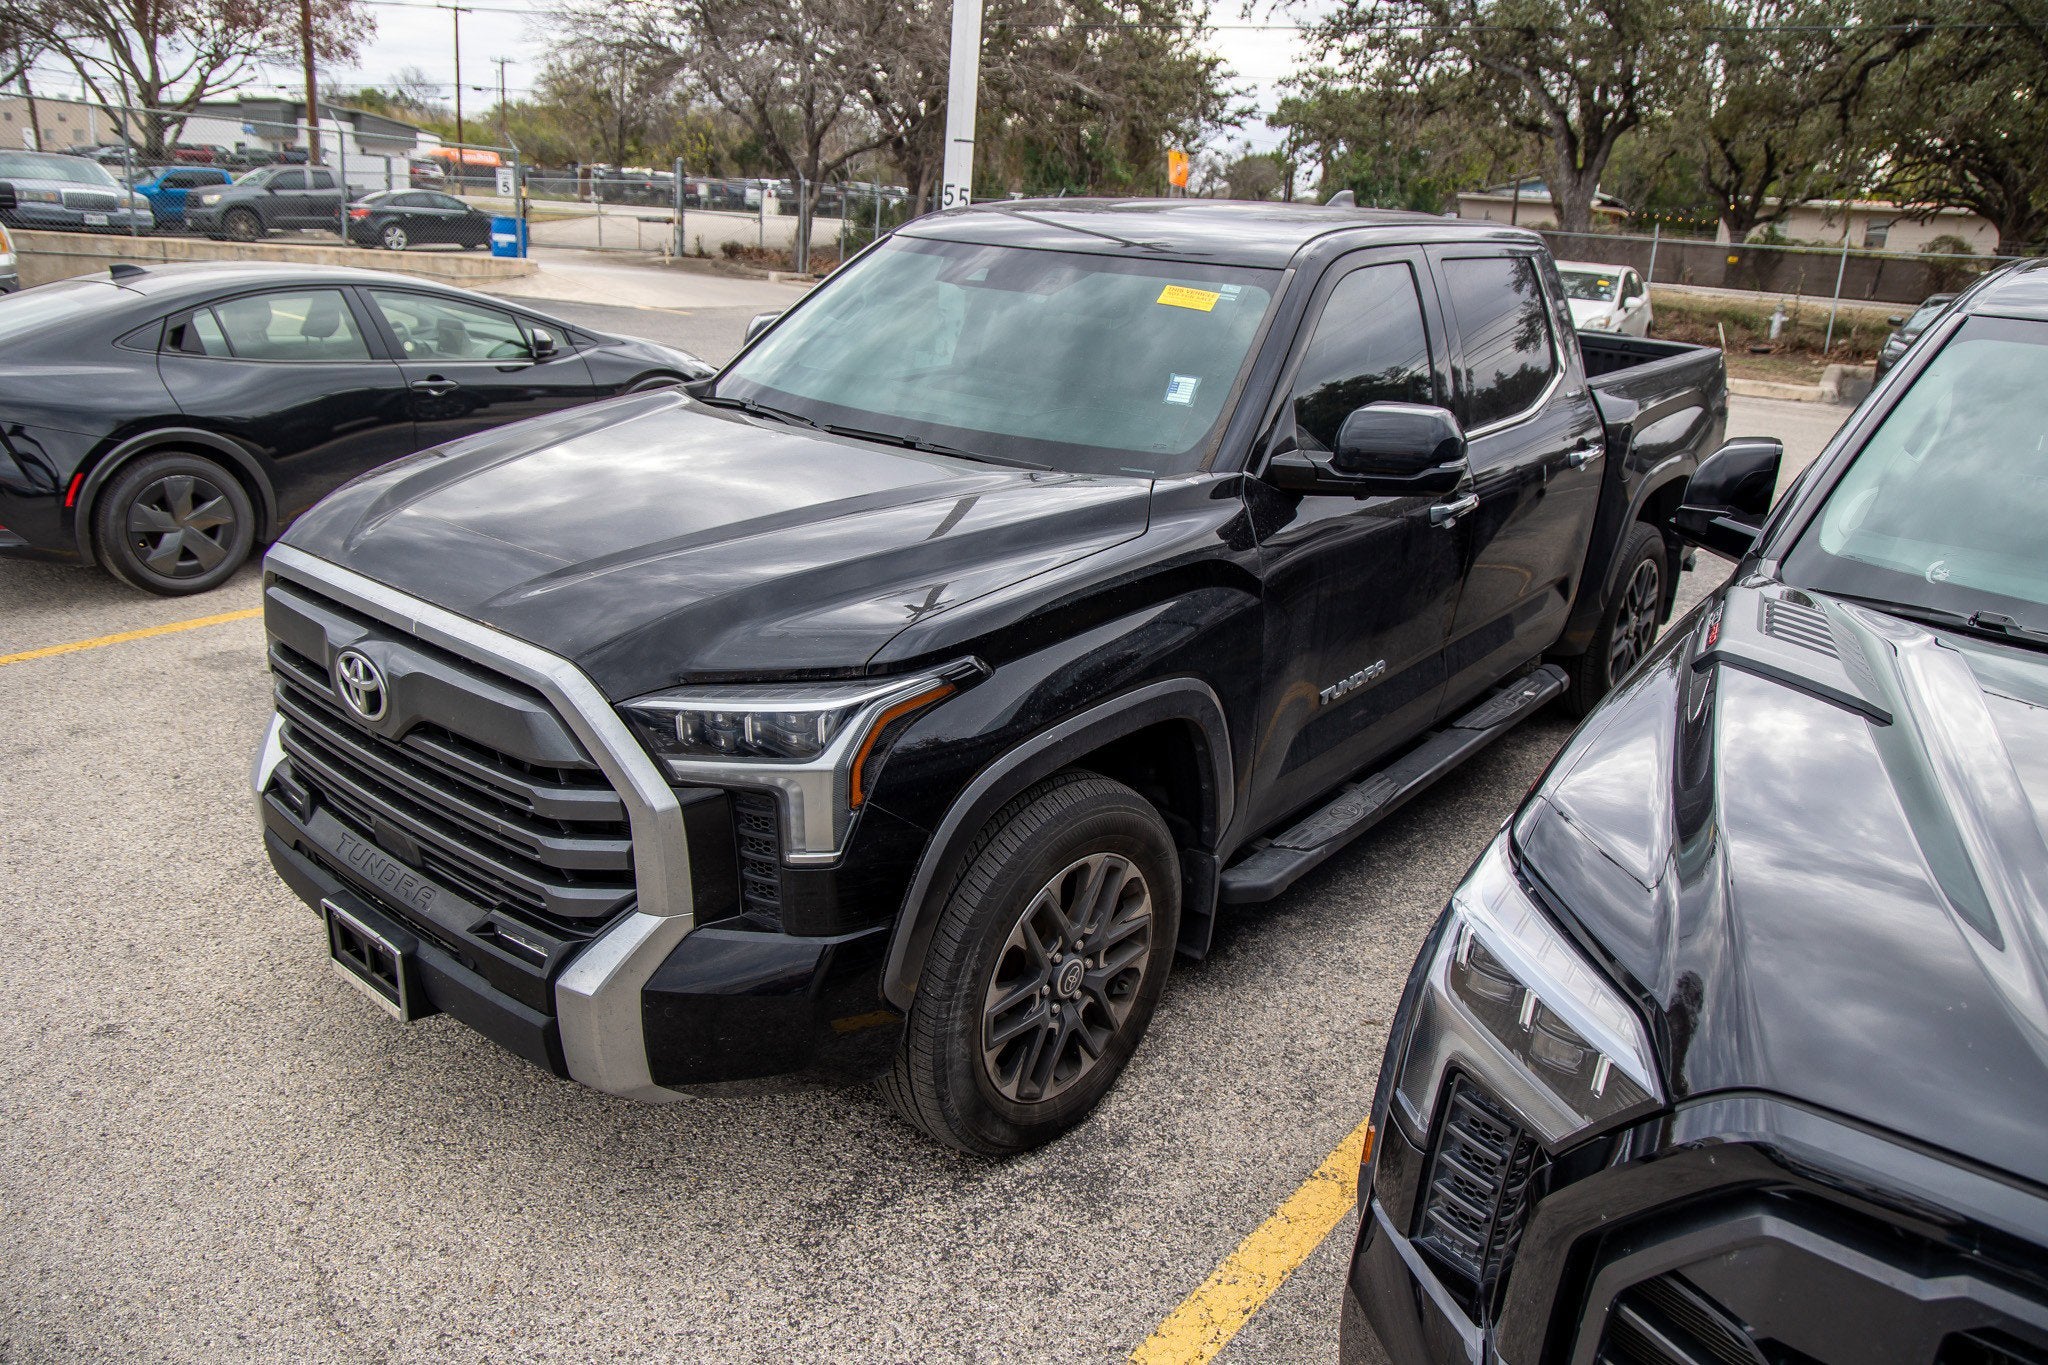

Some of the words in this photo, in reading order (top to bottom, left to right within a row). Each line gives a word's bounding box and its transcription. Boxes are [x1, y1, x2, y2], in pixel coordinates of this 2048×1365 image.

[502, 181, 510, 193] 5
[1320, 659, 1386, 705] TUNDRA
[336, 832, 437, 913] TUNDRA
